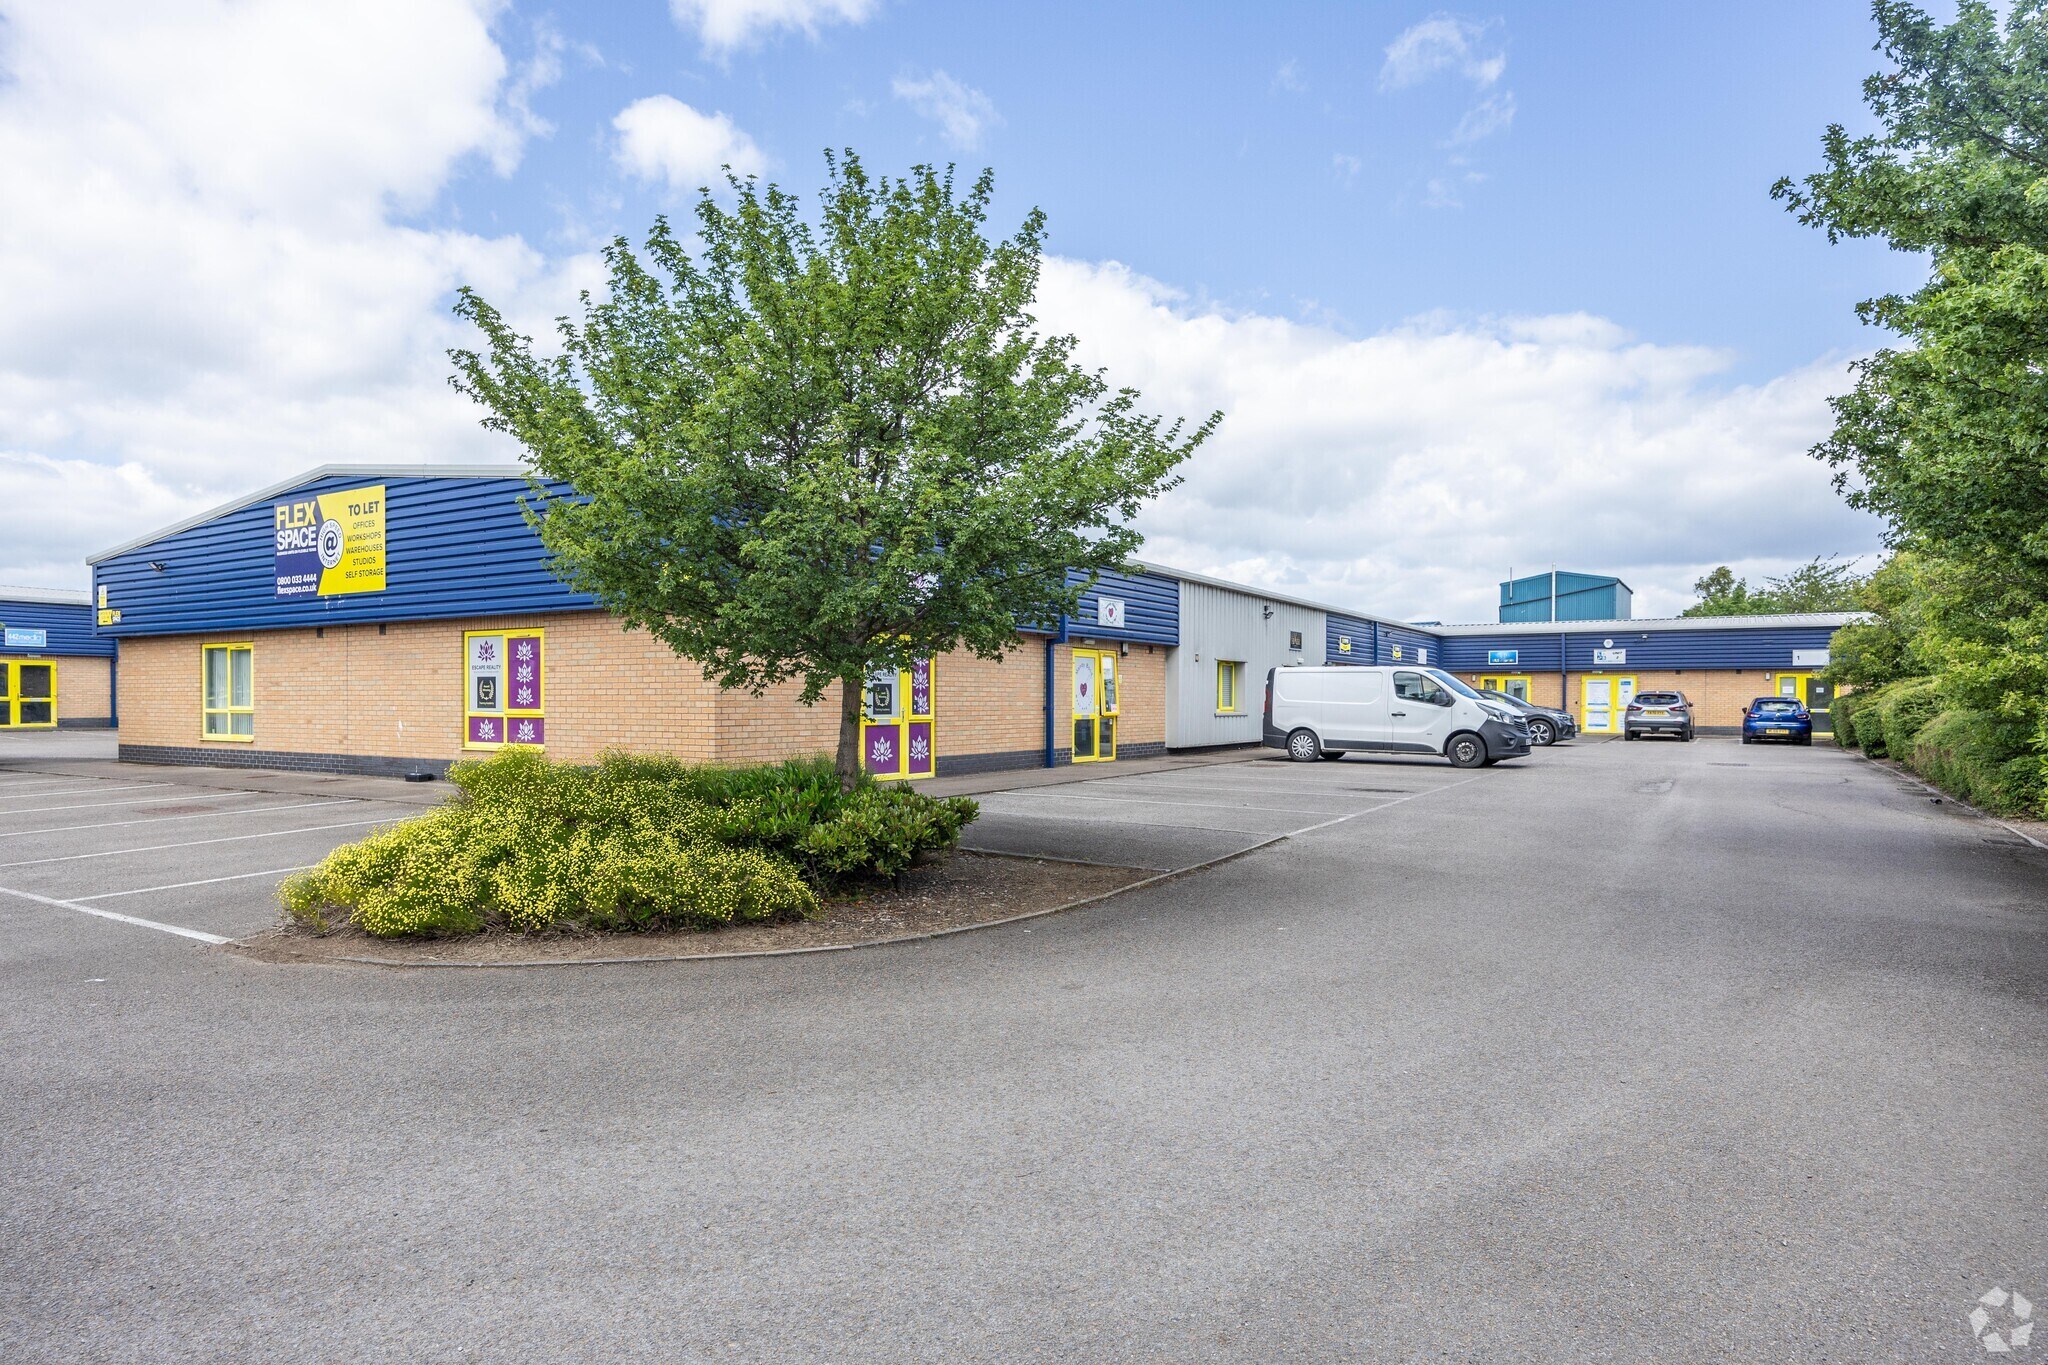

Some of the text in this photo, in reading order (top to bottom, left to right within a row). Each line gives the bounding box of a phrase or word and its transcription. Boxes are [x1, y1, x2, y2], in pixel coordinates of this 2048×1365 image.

[348, 501, 380, 517] TO LET
[276, 501, 317, 530] FLEX
[352, 520, 375, 530] OFFICES
[276, 526, 317, 551] SPACE
[347, 531, 382, 542] WORKSHOPS
[345, 544, 383, 554] WAREHOUSES
[352, 556, 376, 566] STUDIOS
[277, 573, 317, 585] 0800 033 4444
[345, 568, 384, 579] SELF STORAGE
[277, 583, 317, 596] flexspace.co.uk
